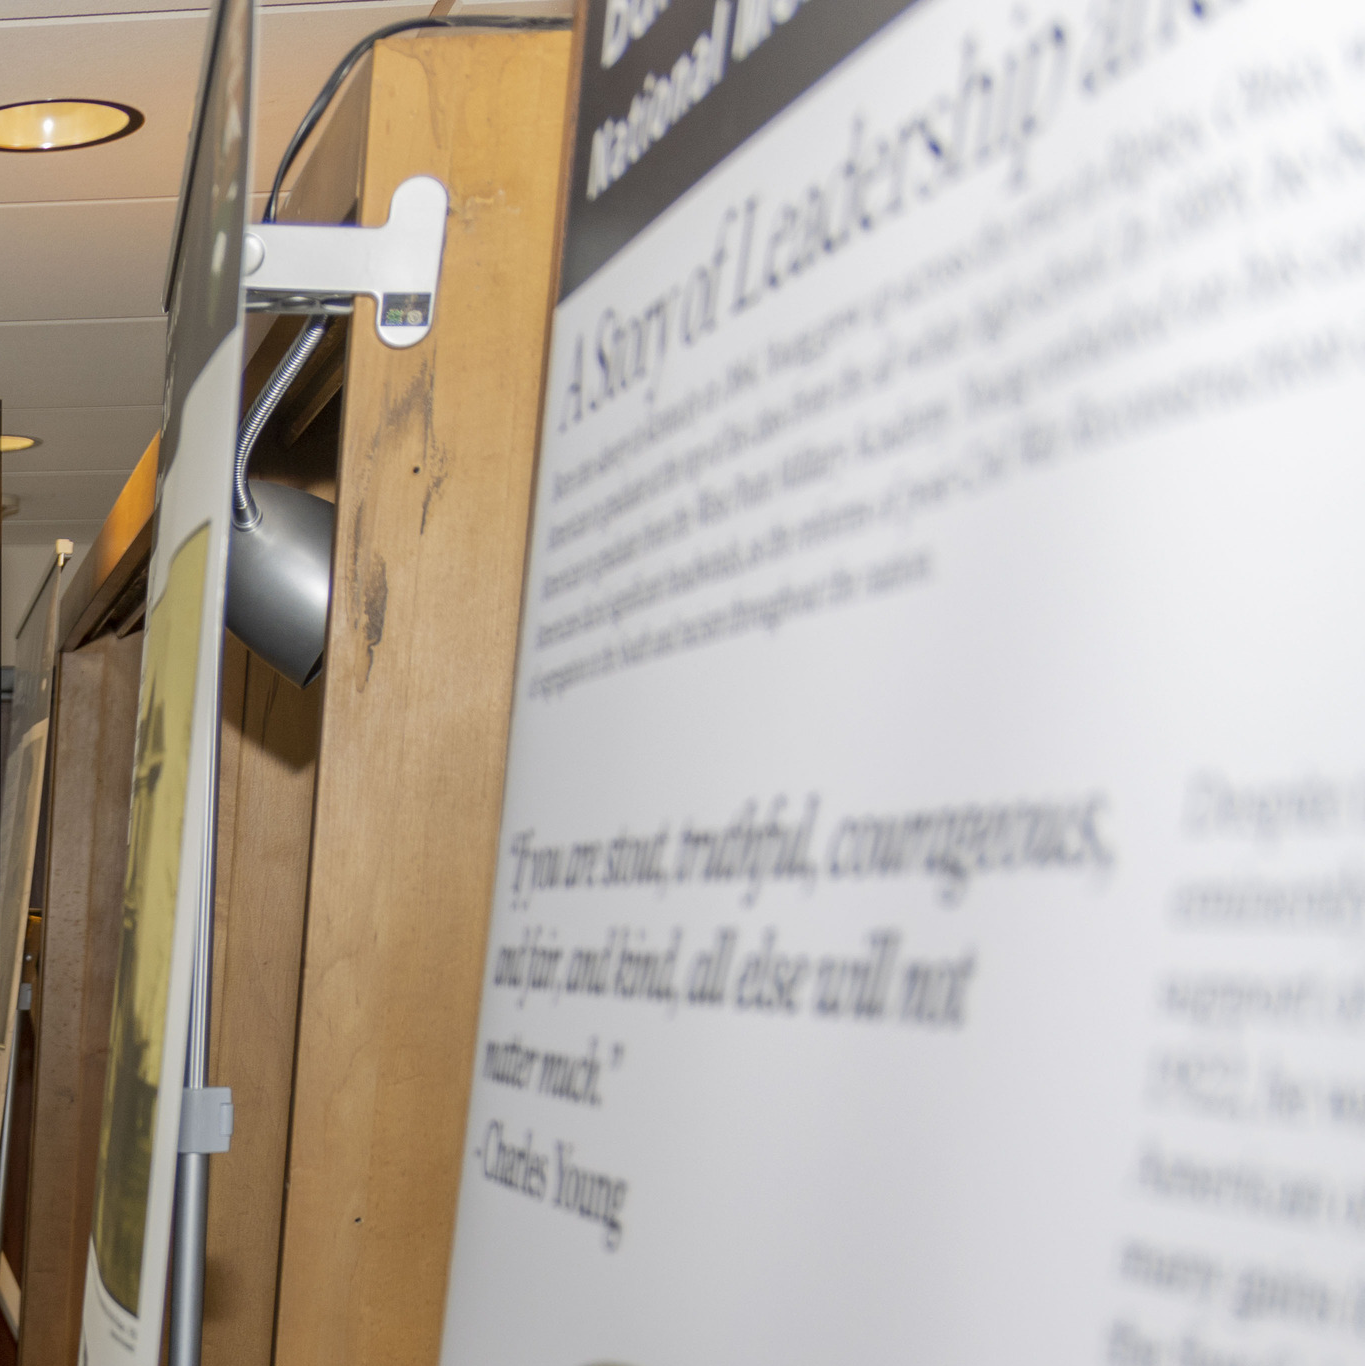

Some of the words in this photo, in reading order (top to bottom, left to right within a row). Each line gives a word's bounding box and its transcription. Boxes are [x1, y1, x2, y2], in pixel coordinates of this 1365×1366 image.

[556, 335, 588, 434] A
[587, 306, 673, 406] Story
[677, 203, 737, 350] of
[731, 3, 1071, 318] Leadership
[673, 790, 823, 912] truthful,
[825, 788, 1119, 912] courageous,
[686, 923, 741, 1008] all
[735, 923, 811, 1017] else
[813, 926, 903, 1022] will
[899, 945, 982, 1032] not
[553, 1138, 629, 1254] Young
